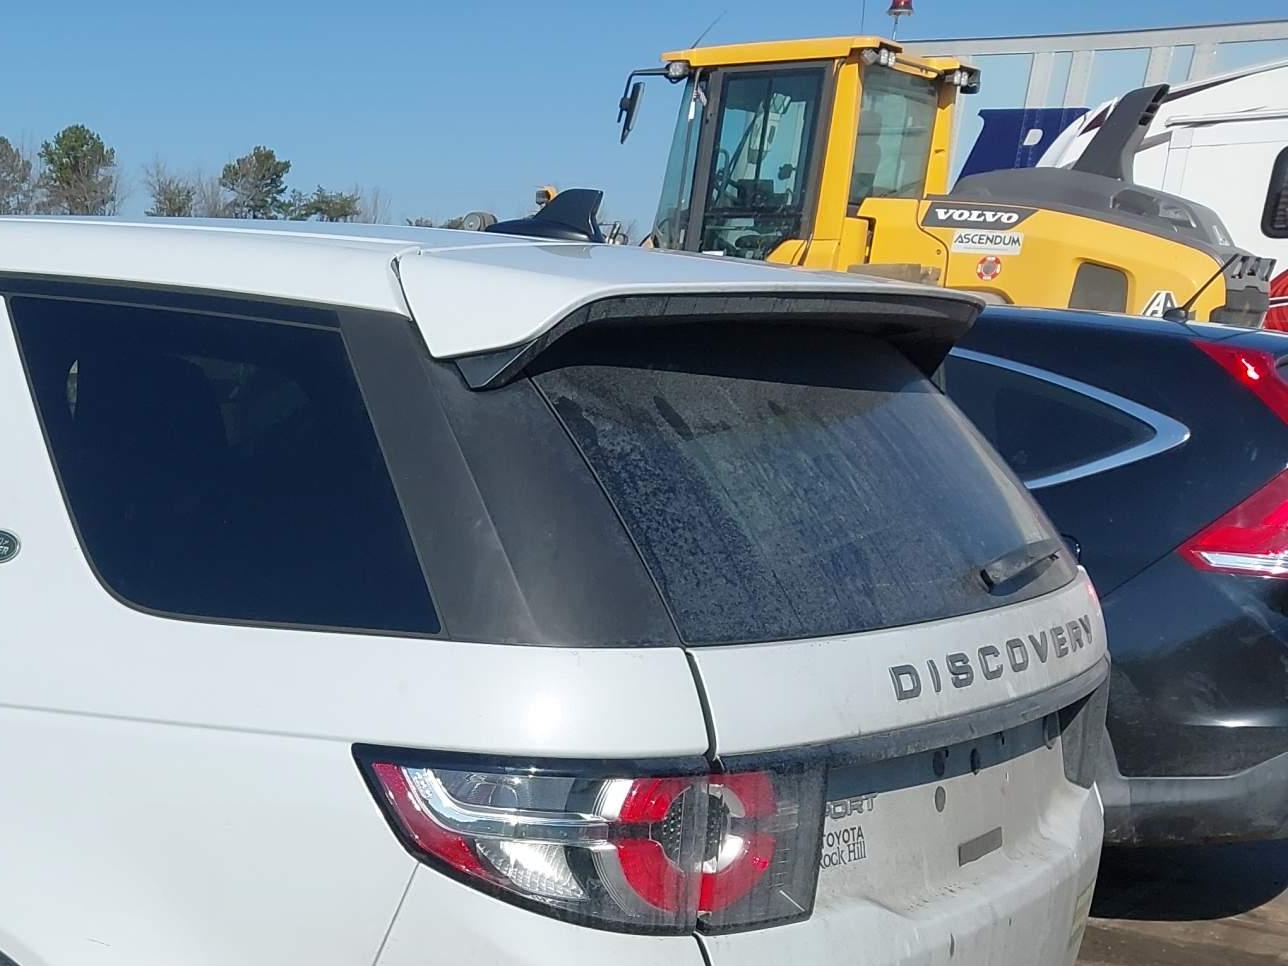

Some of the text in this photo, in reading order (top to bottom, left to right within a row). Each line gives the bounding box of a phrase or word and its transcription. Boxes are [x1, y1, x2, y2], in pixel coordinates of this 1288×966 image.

[935, 208, 1019, 224] VOLVO
[953, 233, 1021, 247] ASCENDUM
[888, 614, 1093, 701] DISCOVERY
[823, 825, 864, 848] OYOTA
[847, 840, 867, 862] Hill
